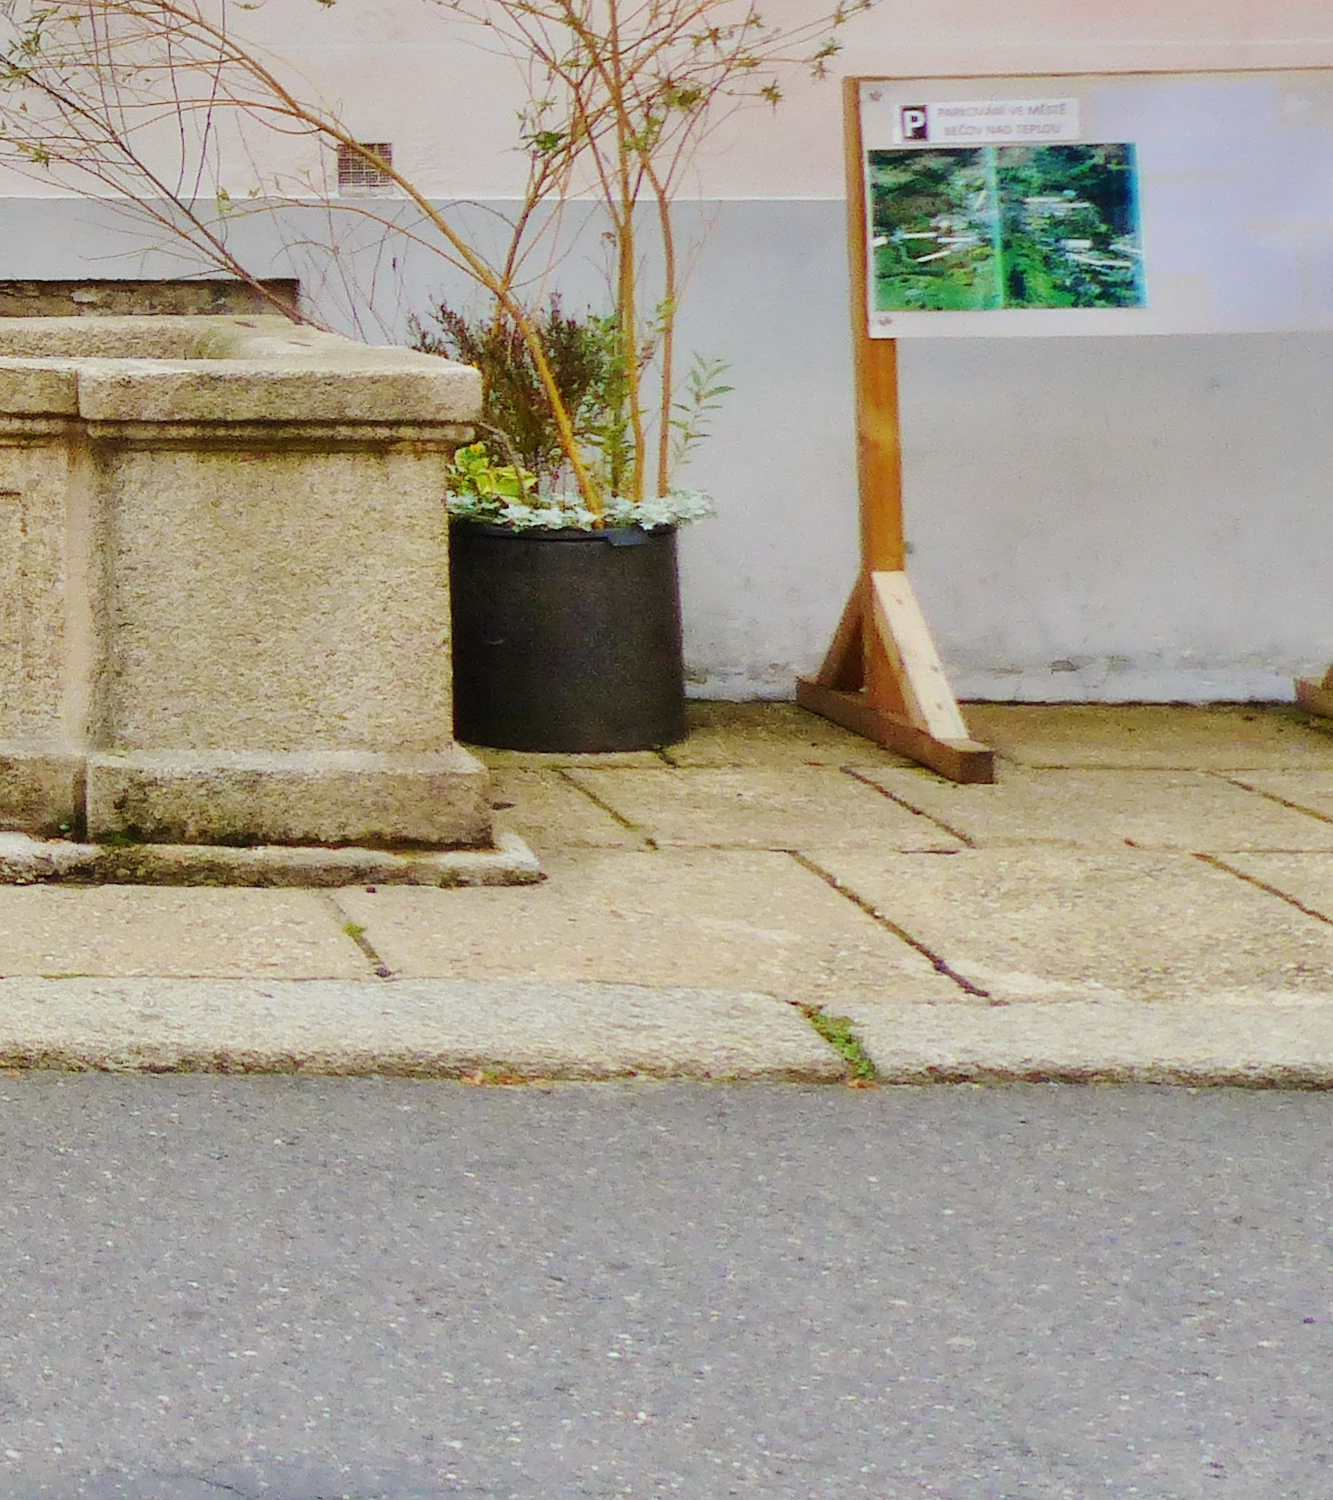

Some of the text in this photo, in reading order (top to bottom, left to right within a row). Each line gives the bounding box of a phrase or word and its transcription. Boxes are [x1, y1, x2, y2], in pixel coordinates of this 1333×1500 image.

[904, 110, 926, 137] P
[986, 125, 1012, 135] NAD
[1016, 124, 1061, 134] TEPLOU
